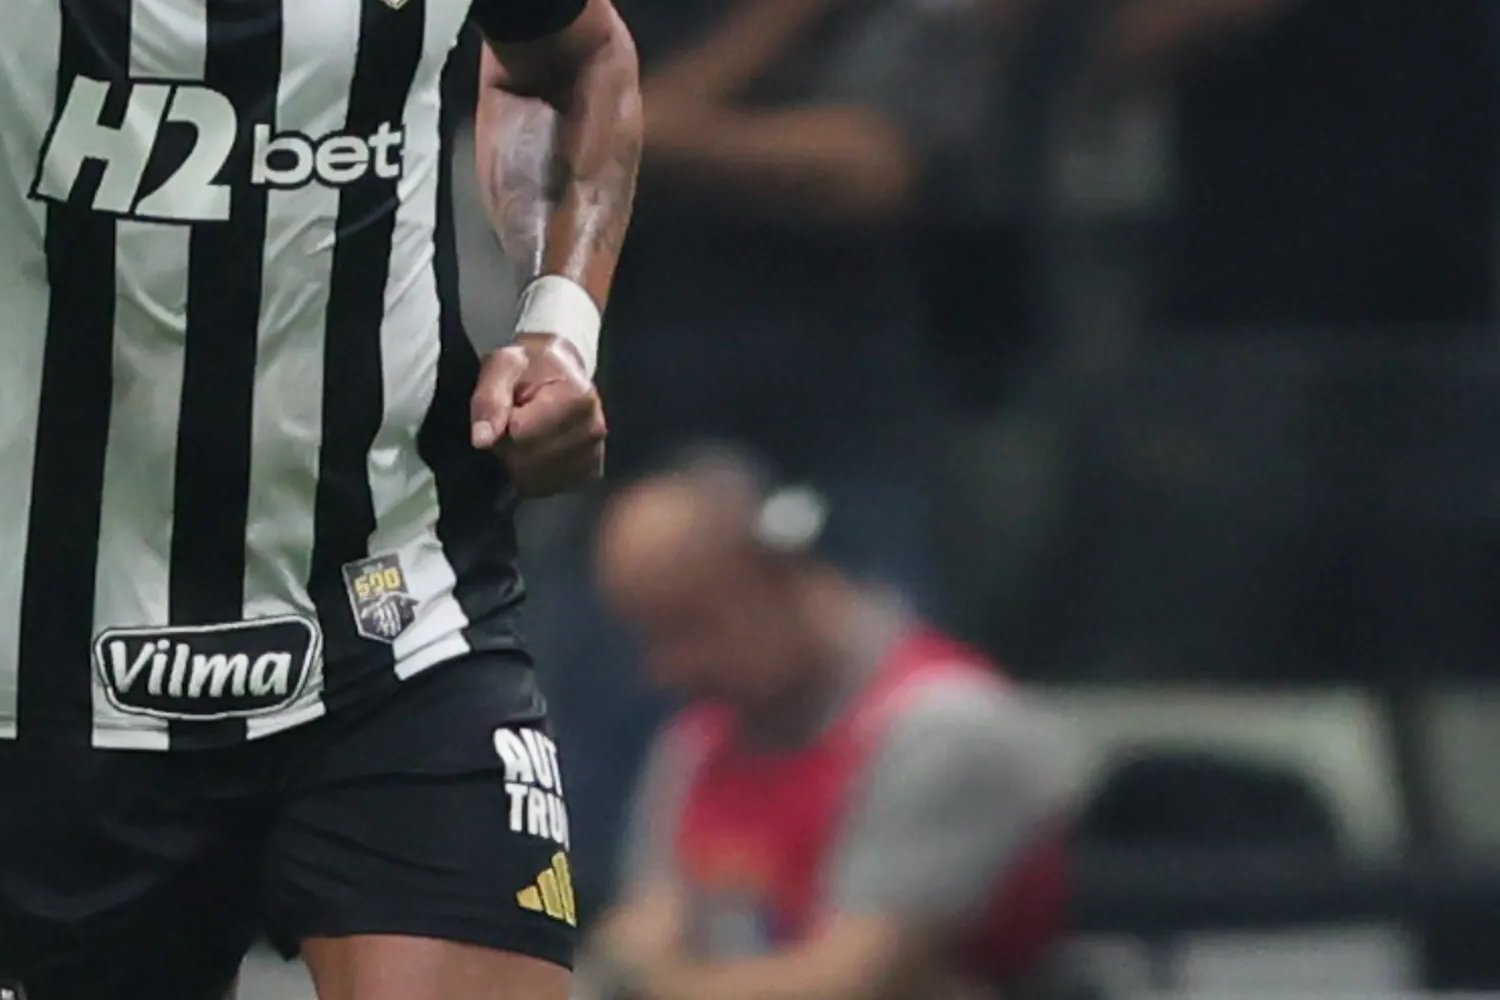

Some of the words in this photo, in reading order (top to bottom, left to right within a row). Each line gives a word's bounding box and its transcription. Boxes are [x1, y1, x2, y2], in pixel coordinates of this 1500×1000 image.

[35, 74, 238, 221] H2
[250, 121, 406, 185] bet
[109, 638, 293, 698] Vilma
[504, 783, 570, 851] TRU
